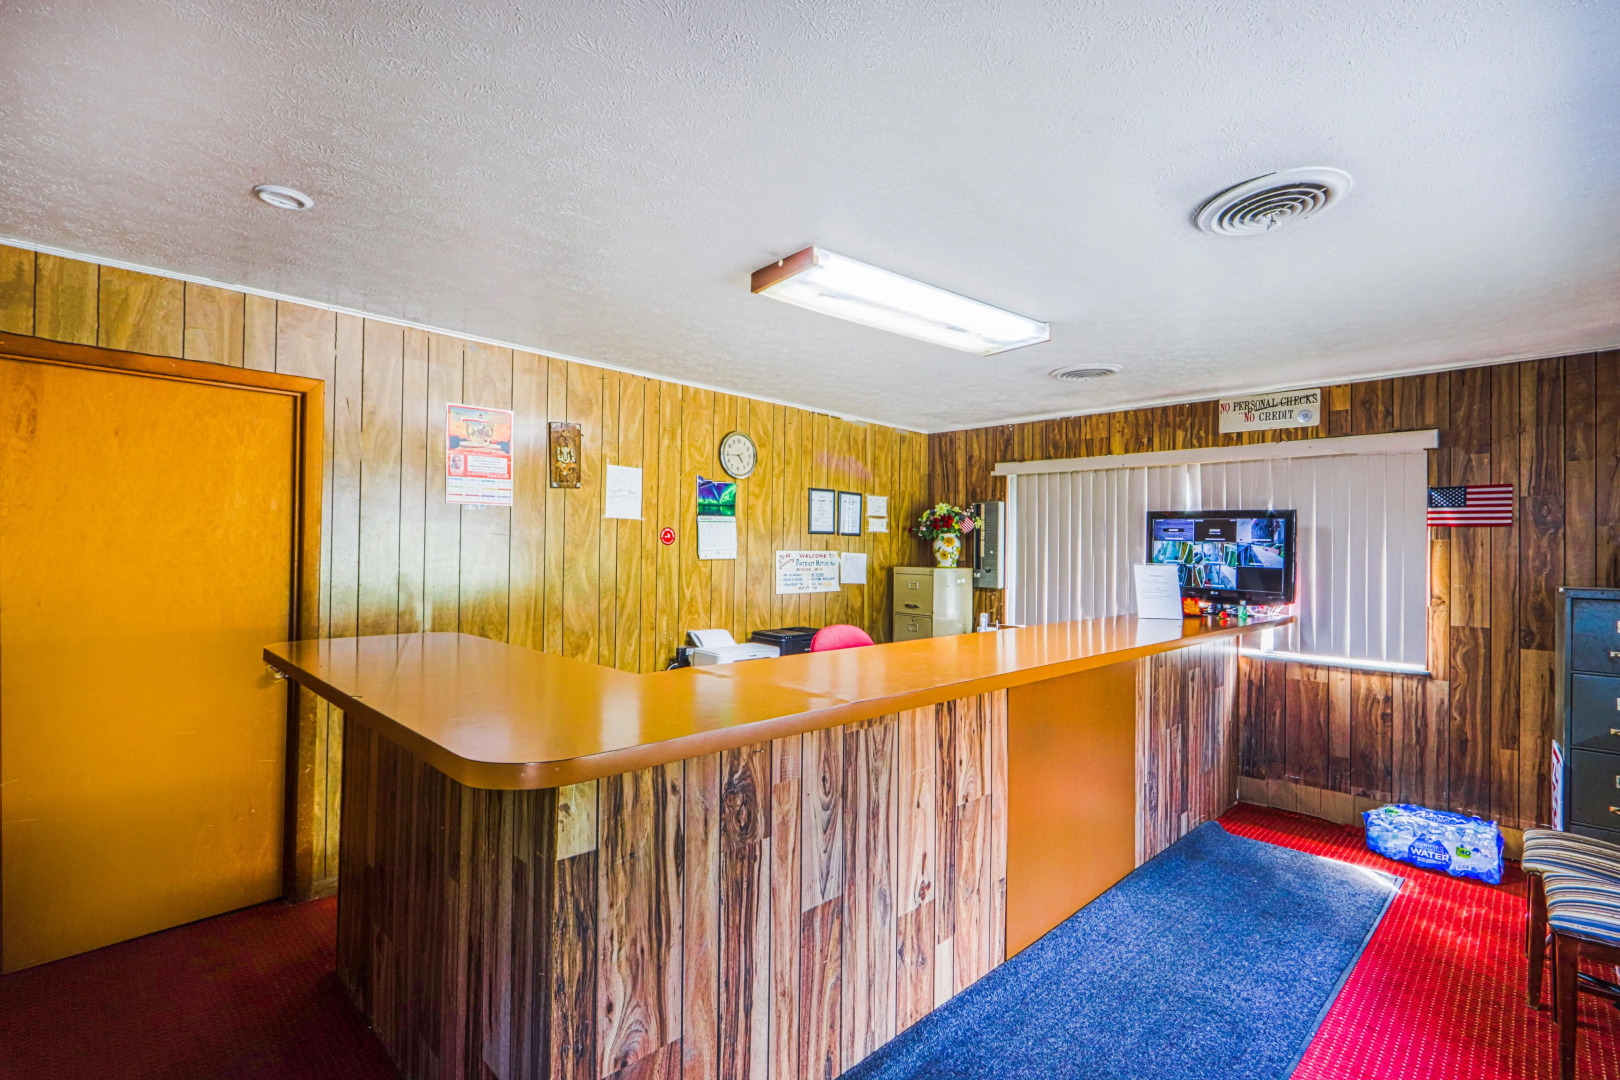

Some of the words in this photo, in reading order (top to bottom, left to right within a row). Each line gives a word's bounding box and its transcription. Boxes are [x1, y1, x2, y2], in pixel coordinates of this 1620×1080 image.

[1220, 403, 1231, 413] NO
[1233, 398, 1278, 412] PERSONAL
[1280, 393, 1318, 407] CHECKS
[1244, 412, 1255, 423] NO
[1258, 409, 1294, 422] CREDIT
[1410, 847, 1449, 862] WATER
